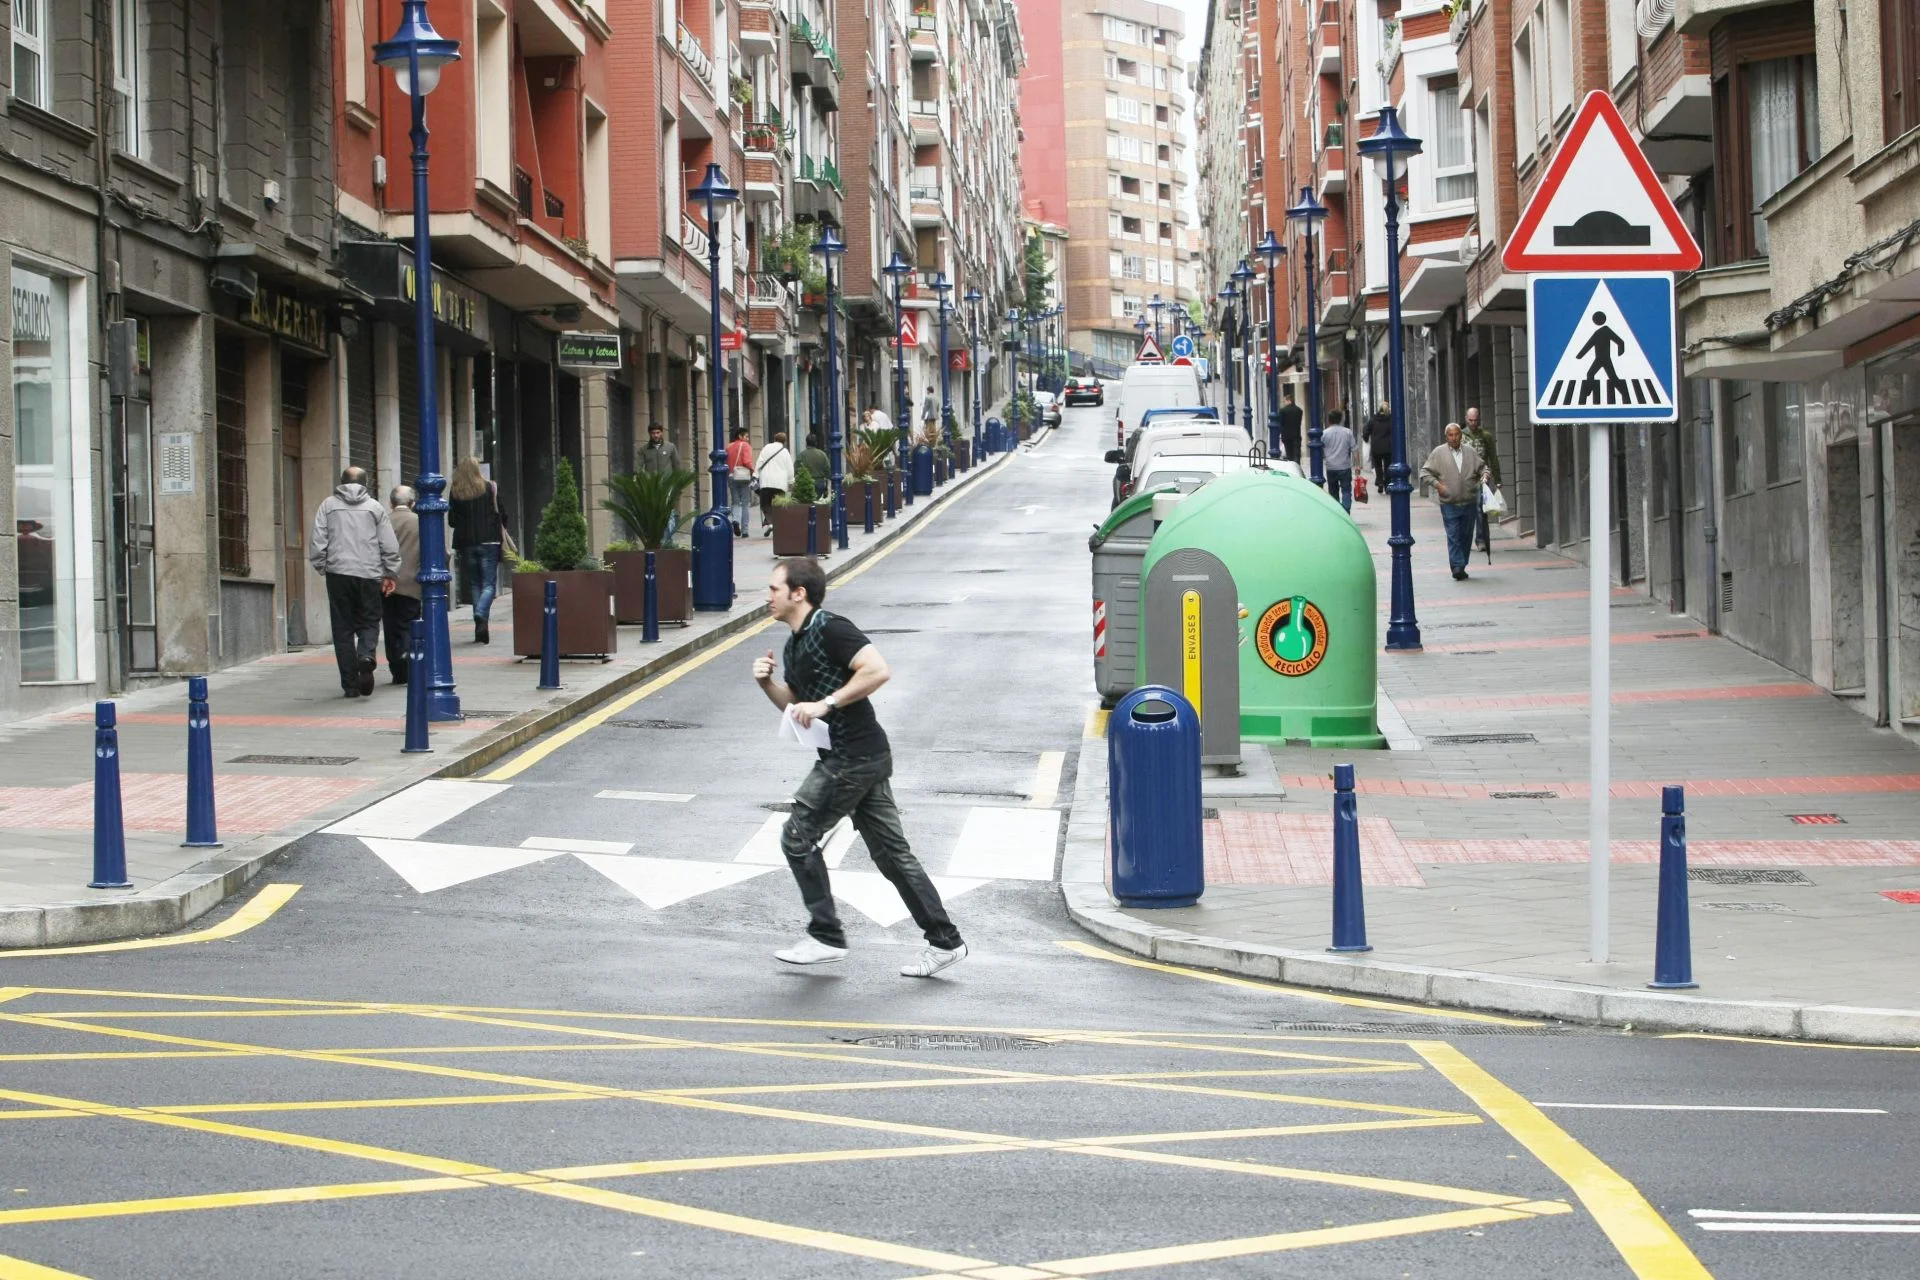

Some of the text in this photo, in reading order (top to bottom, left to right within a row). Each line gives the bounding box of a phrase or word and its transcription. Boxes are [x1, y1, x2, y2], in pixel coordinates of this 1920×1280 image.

[12, 286, 51, 341] SEGUROS
[560, 342, 618, 359] Letras y letras
[1271, 604, 1288, 618] tener
[1260, 614, 1275, 634] puede
[1187, 614, 1196, 660] ENVASES
[1260, 636, 1272, 654] vidrio
[1273, 650, 1321, 674] RECICLALO
